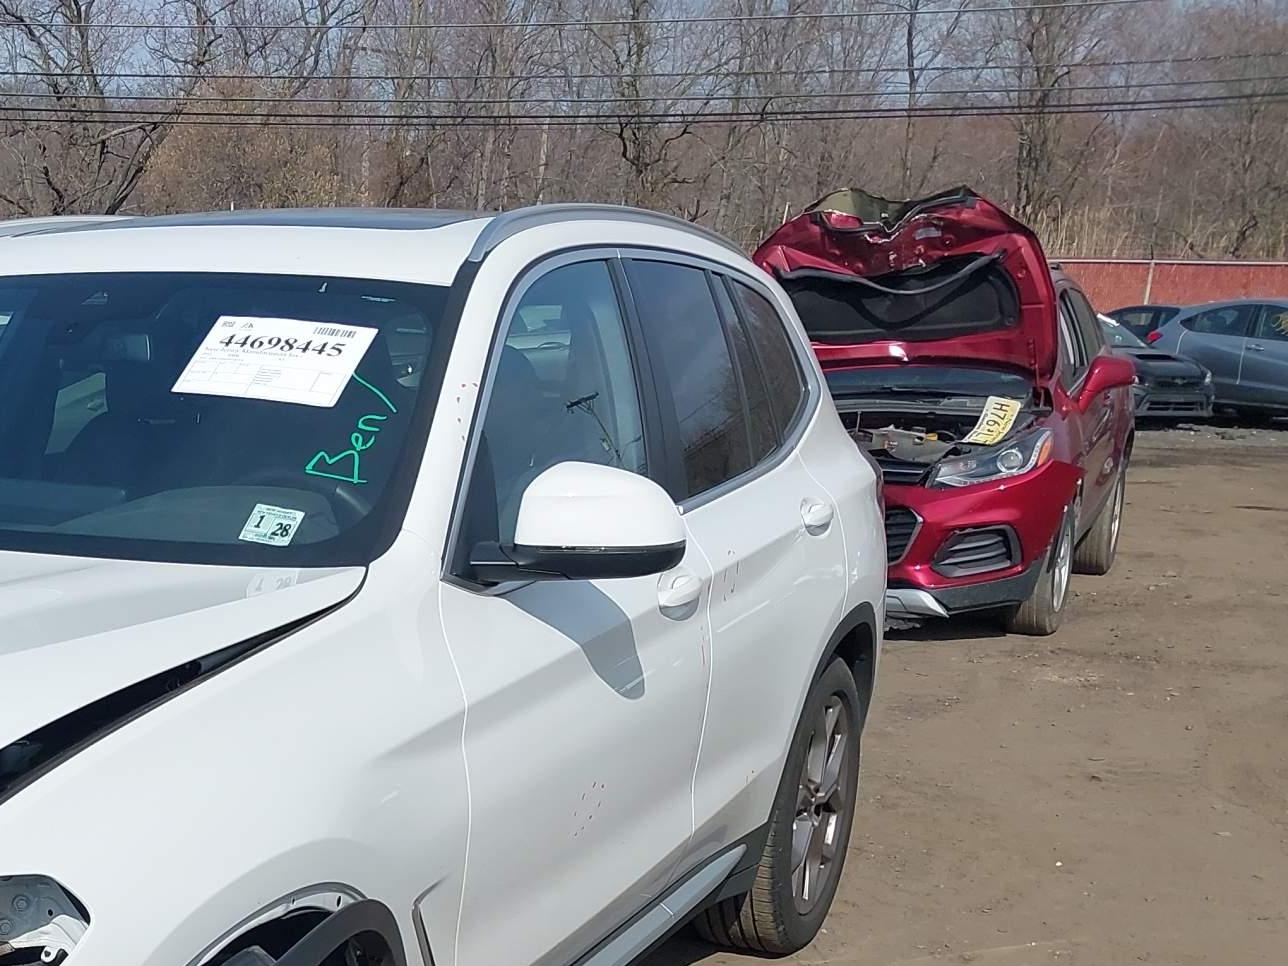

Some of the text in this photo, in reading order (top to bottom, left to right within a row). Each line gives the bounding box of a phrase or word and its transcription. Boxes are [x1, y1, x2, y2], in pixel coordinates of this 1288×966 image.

[219, 333, 347, 357] 44698445
[253, 514, 265, 528] 1
[270, 522, 291, 537] 28
